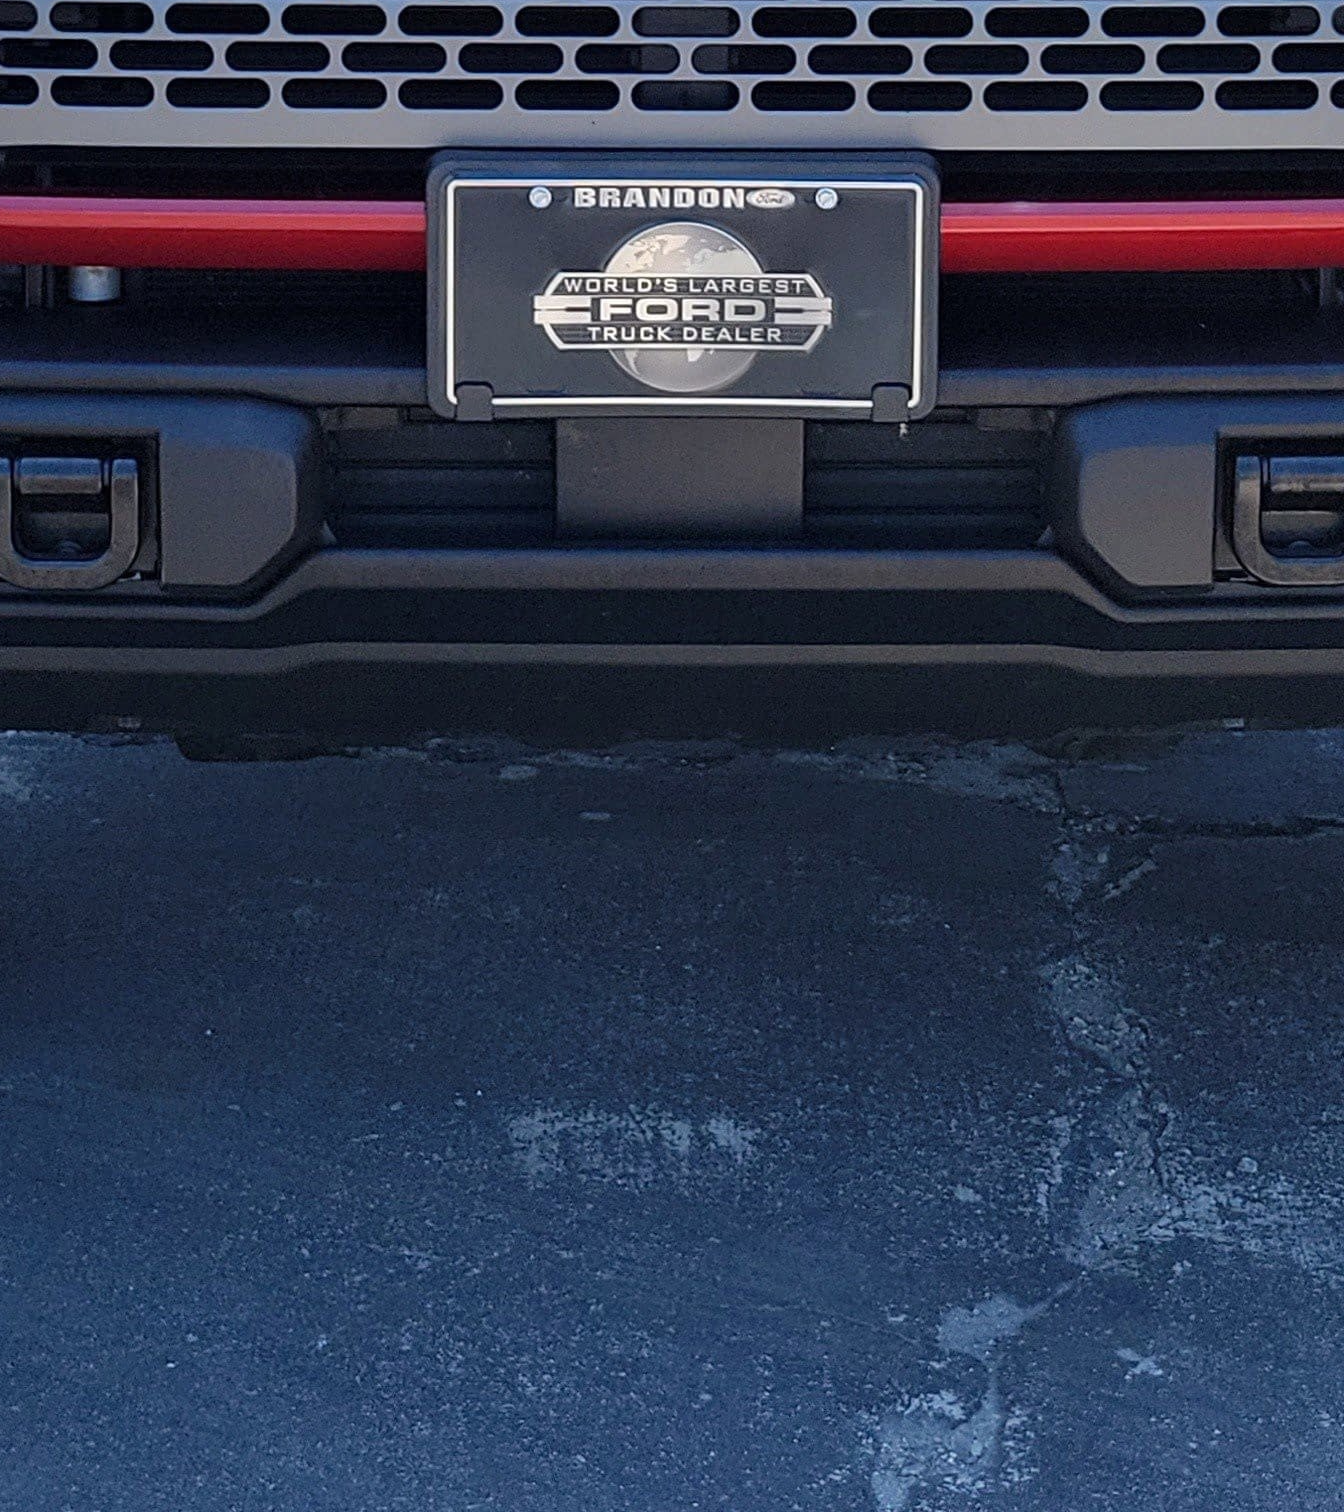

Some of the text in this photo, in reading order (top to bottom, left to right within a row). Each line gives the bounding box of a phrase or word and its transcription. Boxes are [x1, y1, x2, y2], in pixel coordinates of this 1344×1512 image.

[574, 188, 744, 208] BRANDON
[564, 278, 805, 294] WORLD'S LARGEST
[600, 298, 766, 322] FORD
[587, 326, 782, 342] TRUCK DEALER
